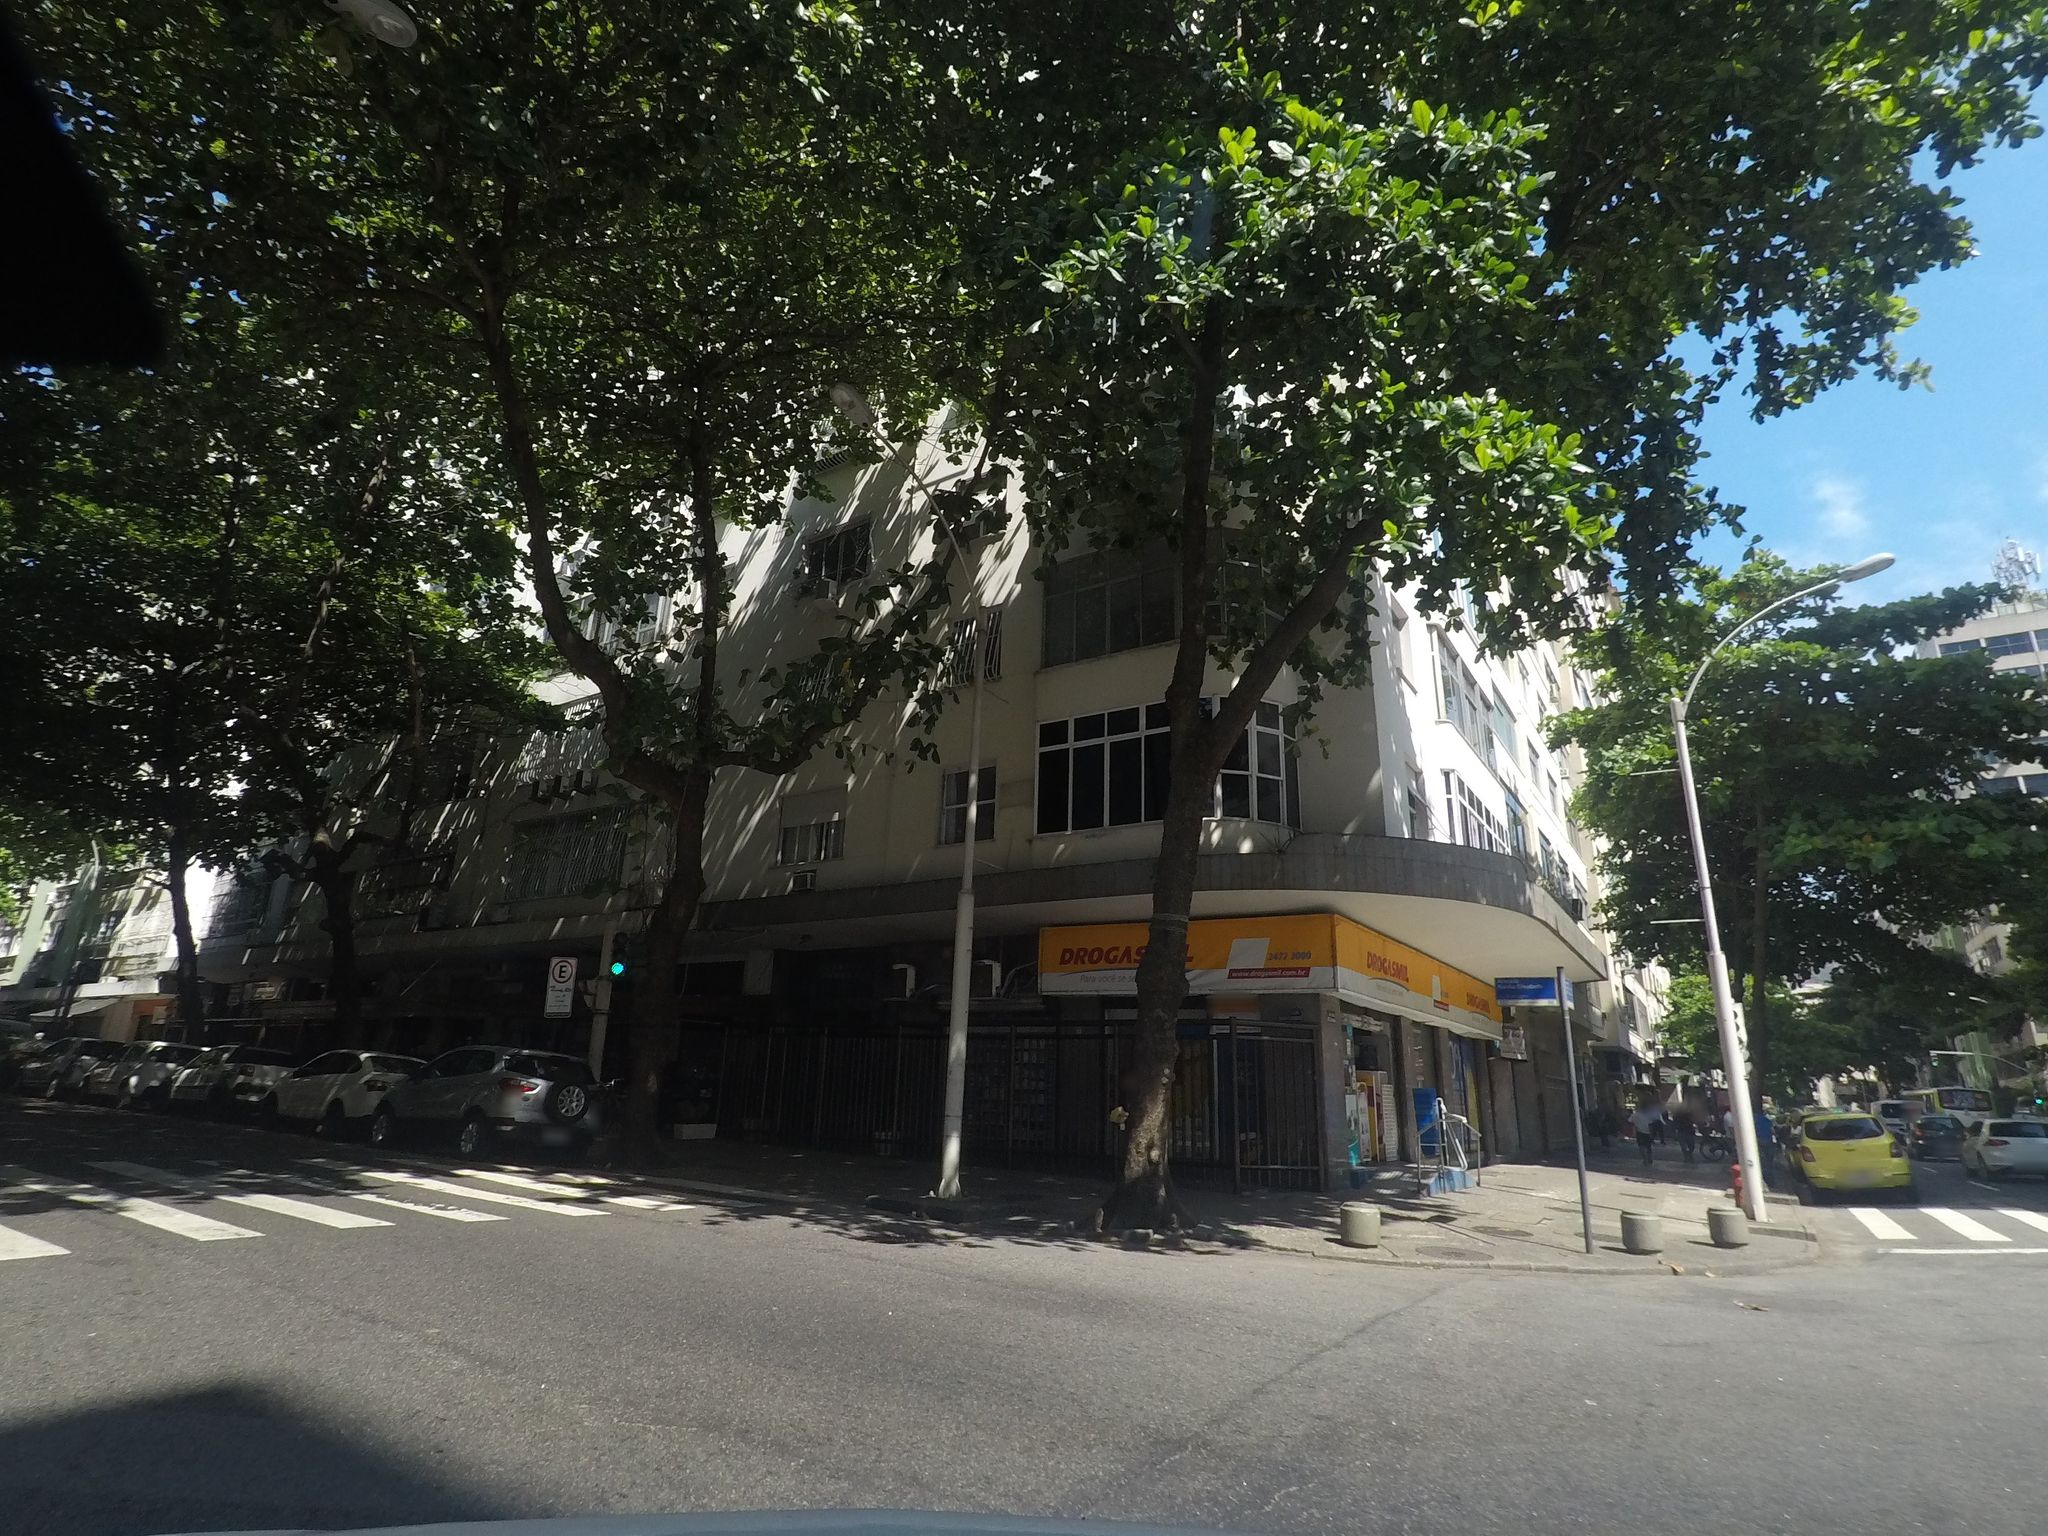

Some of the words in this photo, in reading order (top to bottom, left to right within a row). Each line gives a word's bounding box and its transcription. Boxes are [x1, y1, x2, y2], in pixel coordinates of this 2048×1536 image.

[1059, 944, 1194, 965] DROGASL
[558, 965, 568, 979] E
[1367, 951, 1409, 983] DROGASMIL
